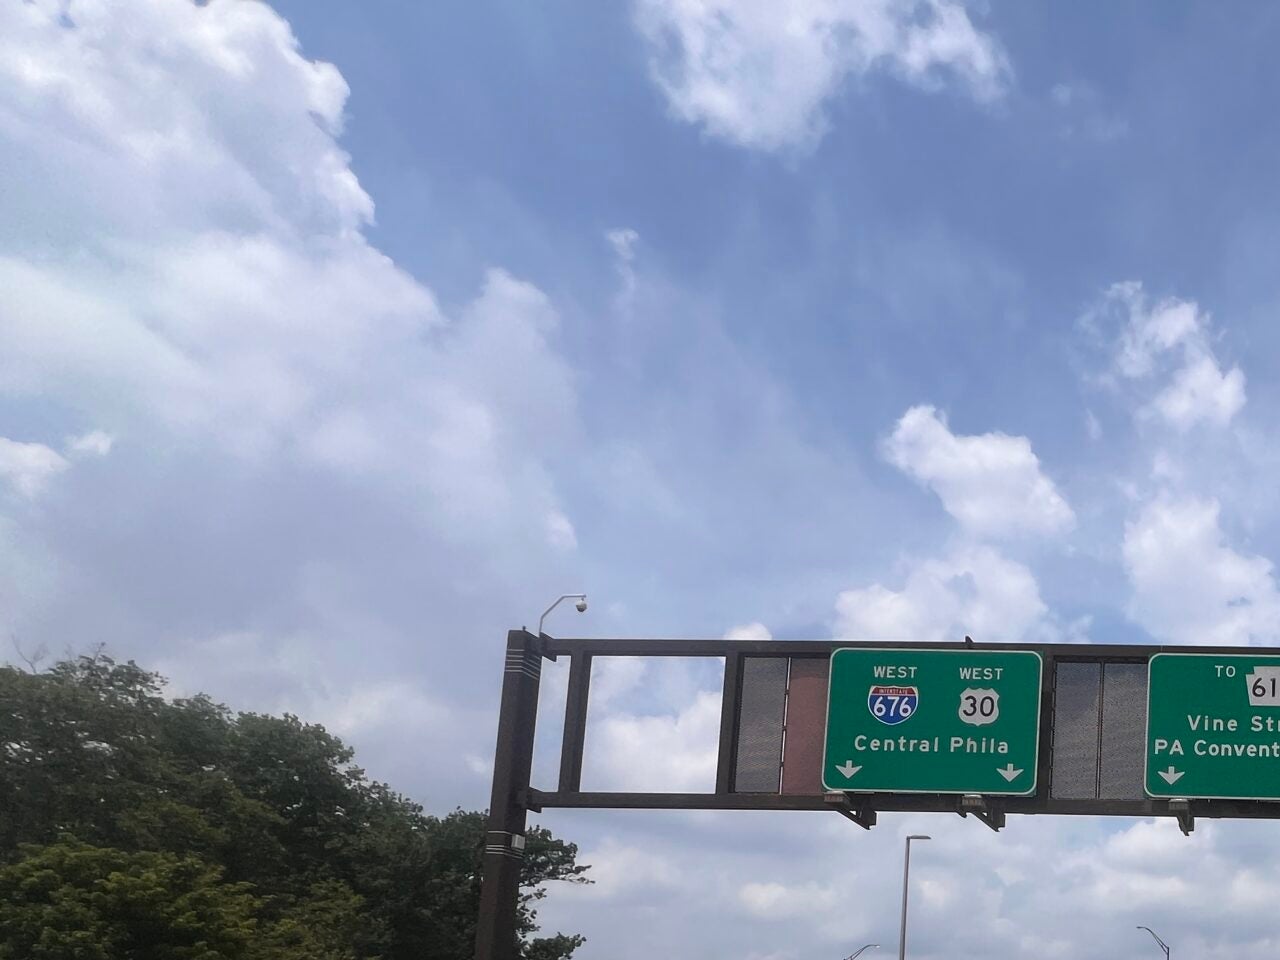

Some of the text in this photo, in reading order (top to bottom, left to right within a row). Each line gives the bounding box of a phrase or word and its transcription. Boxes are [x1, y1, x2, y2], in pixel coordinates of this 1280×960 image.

[873, 666, 918, 679] WEST
[959, 667, 1004, 680] WEST
[1214, 665, 1236, 678] TO
[873, 696, 912, 717] 676
[962, 695, 995, 717] 30
[1187, 714, 1238, 732] Vine
[854, 735, 1009, 754] Central Phila
[1154, 739, 1184, 756] PA
